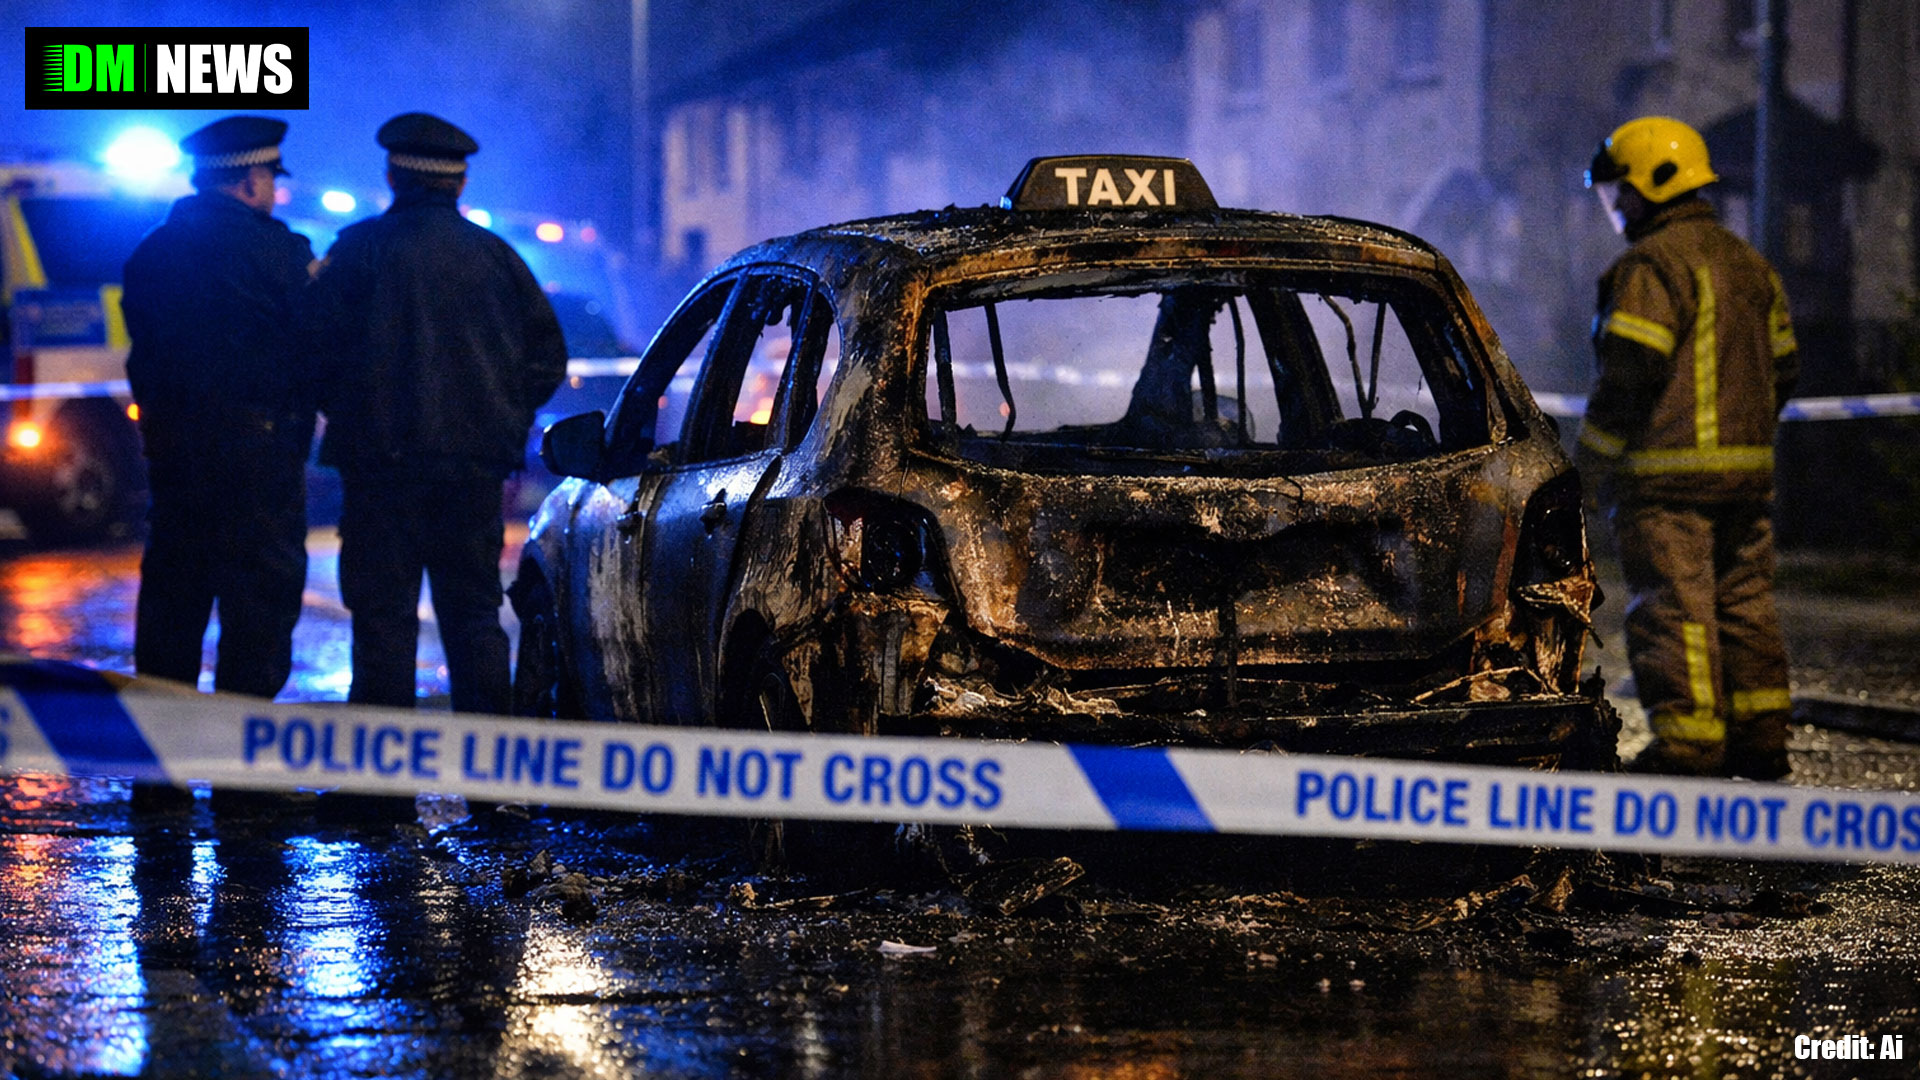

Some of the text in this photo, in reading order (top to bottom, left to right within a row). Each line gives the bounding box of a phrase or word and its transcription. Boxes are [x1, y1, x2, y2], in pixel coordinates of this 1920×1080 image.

[1054, 167, 1177, 206] TAXI
[243, 716, 1003, 810] POLICE LINE DO NOT CROSS
[1296, 770, 1469, 826] POLICE
[1488, 782, 1595, 833] LINE
[1613, 790, 1678, 838] DO
[1696, 795, 1787, 843] NOT
